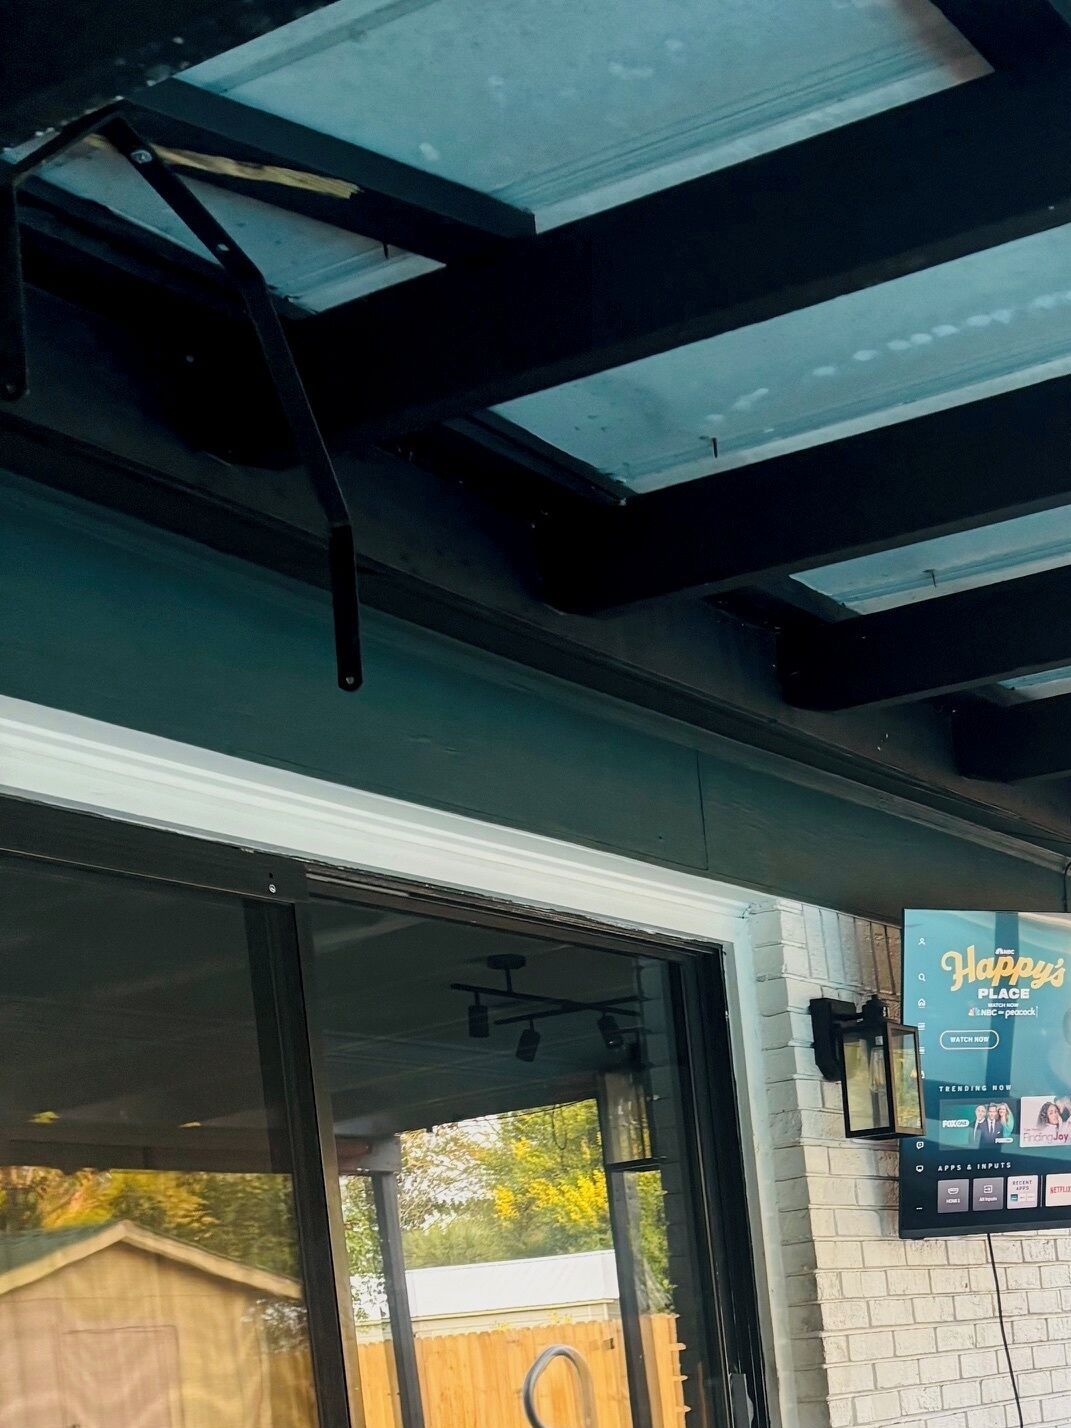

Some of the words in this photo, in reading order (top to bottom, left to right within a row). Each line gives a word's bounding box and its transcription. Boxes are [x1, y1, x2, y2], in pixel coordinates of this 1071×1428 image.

[941, 944, 1066, 992] Happy's
[977, 988, 1030, 999] PLACE
[1005, 1008, 1036, 1019] peacock
[938, 1084, 987, 1092] TRENDING
[942, 1119, 957, 1128] FOX
[1054, 1130, 1069, 1142] Joy
[977, 1162, 1012, 1170] INPUTS
[1049, 1185, 1071, 1195] NETFLIX
